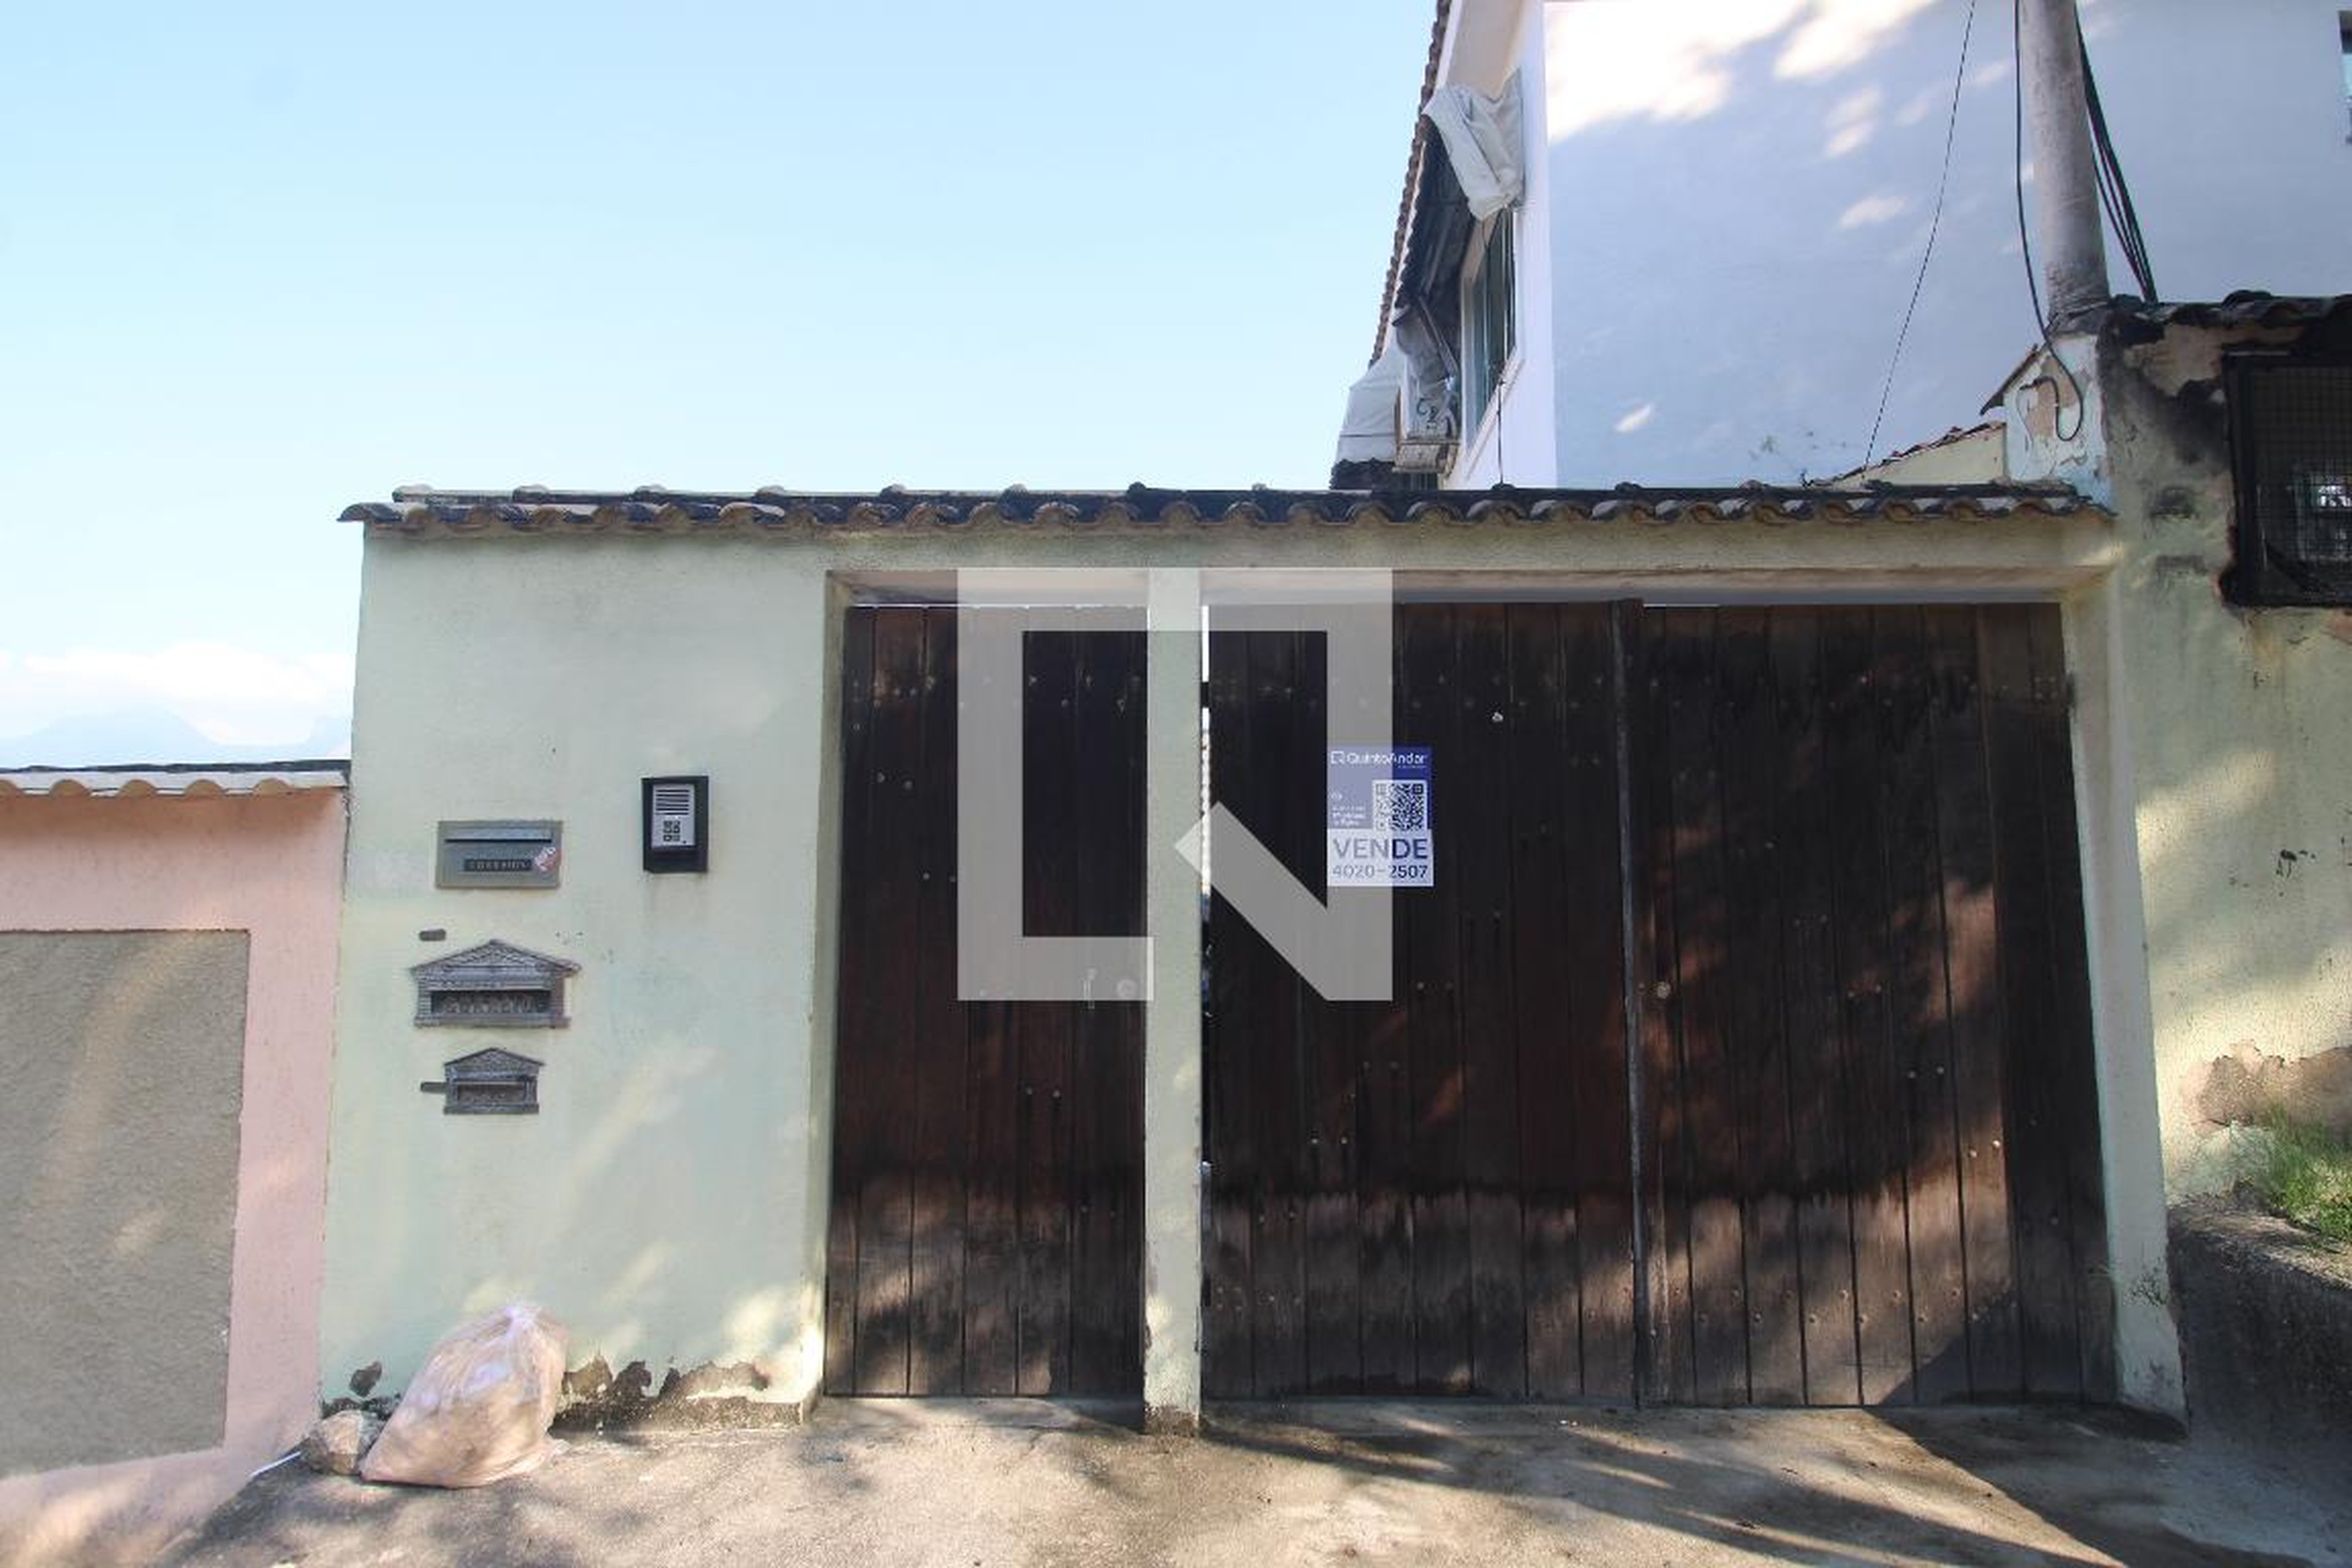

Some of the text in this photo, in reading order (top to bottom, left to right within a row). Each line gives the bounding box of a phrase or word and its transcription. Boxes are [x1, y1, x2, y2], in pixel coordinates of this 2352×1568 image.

[1347, 752, 1425, 765] QuintoAndar
[1333, 838, 1428, 859] VENDE
[1332, 864, 1428, 878] 4020-2507
